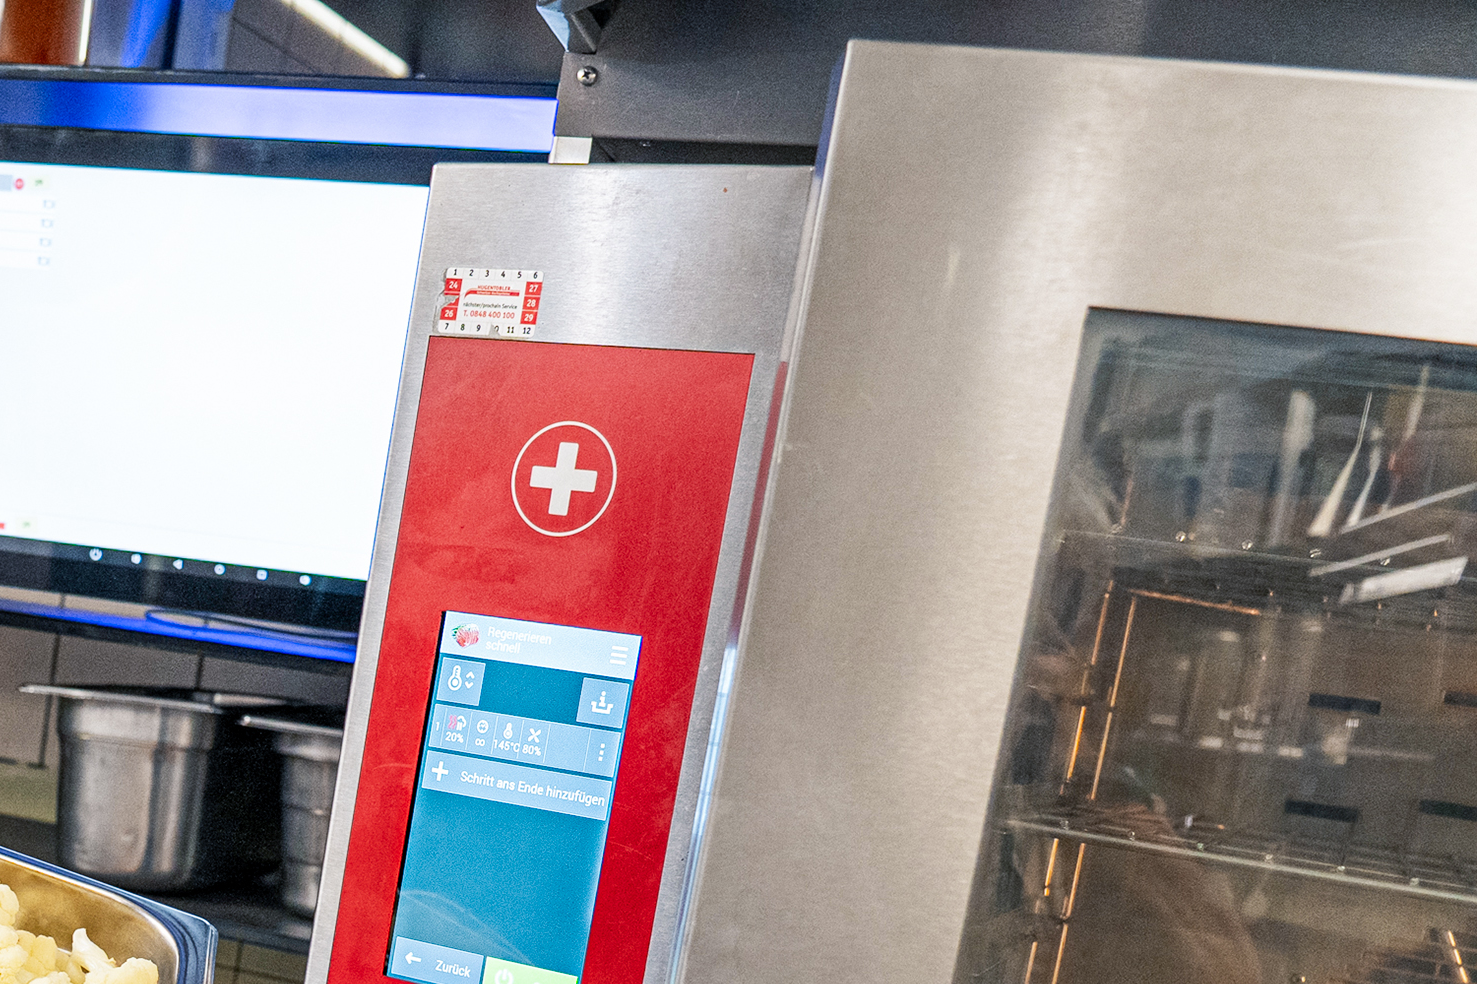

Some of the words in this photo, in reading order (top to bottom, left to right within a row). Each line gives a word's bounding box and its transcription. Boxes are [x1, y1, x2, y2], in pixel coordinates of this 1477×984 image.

[517, 271, 522, 279] 5
[448, 281, 458, 289] 24
[529, 284, 538, 292] 27
[526, 299, 536, 307] 28
[444, 309, 454, 317] 26
[524, 313, 534, 322] 29
[460, 323, 465, 331] 8
[476, 324, 481, 332] 9
[487, 626, 552, 646] Regenerieren
[485, 640, 521, 654] schnell
[445, 732, 464, 744] 20%
[493, 740, 520, 753] 145°C
[522, 744, 542, 756] 80%
[460, 771, 494, 787] Schritt
[496, 778, 515, 791] ans
[517, 782, 544, 796] Ende
[546, 785, 605, 807] hinzufügen
[435, 959, 471, 978] Zurück
